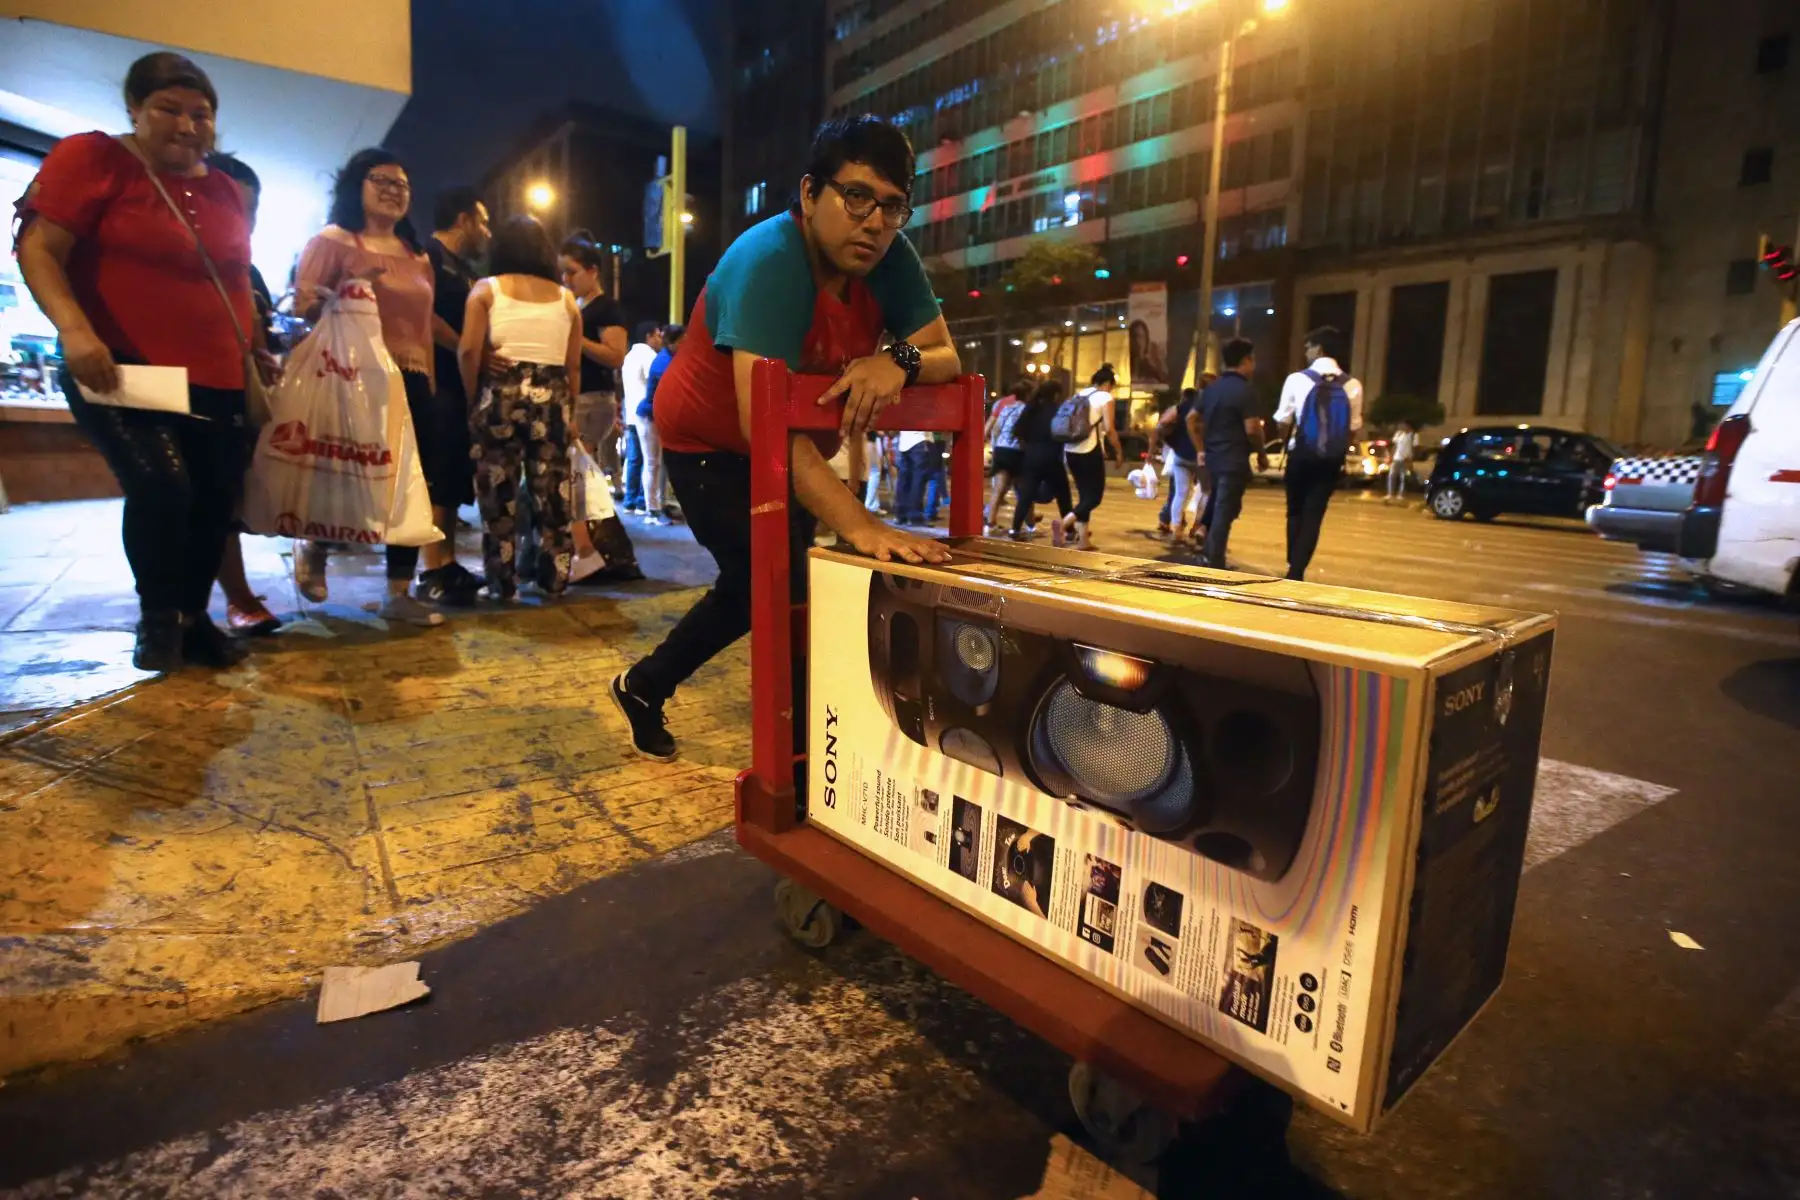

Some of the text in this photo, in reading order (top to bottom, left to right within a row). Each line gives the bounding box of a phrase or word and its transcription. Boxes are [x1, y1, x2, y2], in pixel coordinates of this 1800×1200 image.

[1444, 682, 1485, 716] SONY
[824, 704, 838, 809] SONY
[1230, 980, 1242, 1016] Football
[1238, 994, 1248, 1020] mode
[1330, 1004, 1347, 1043] Bluetooth
